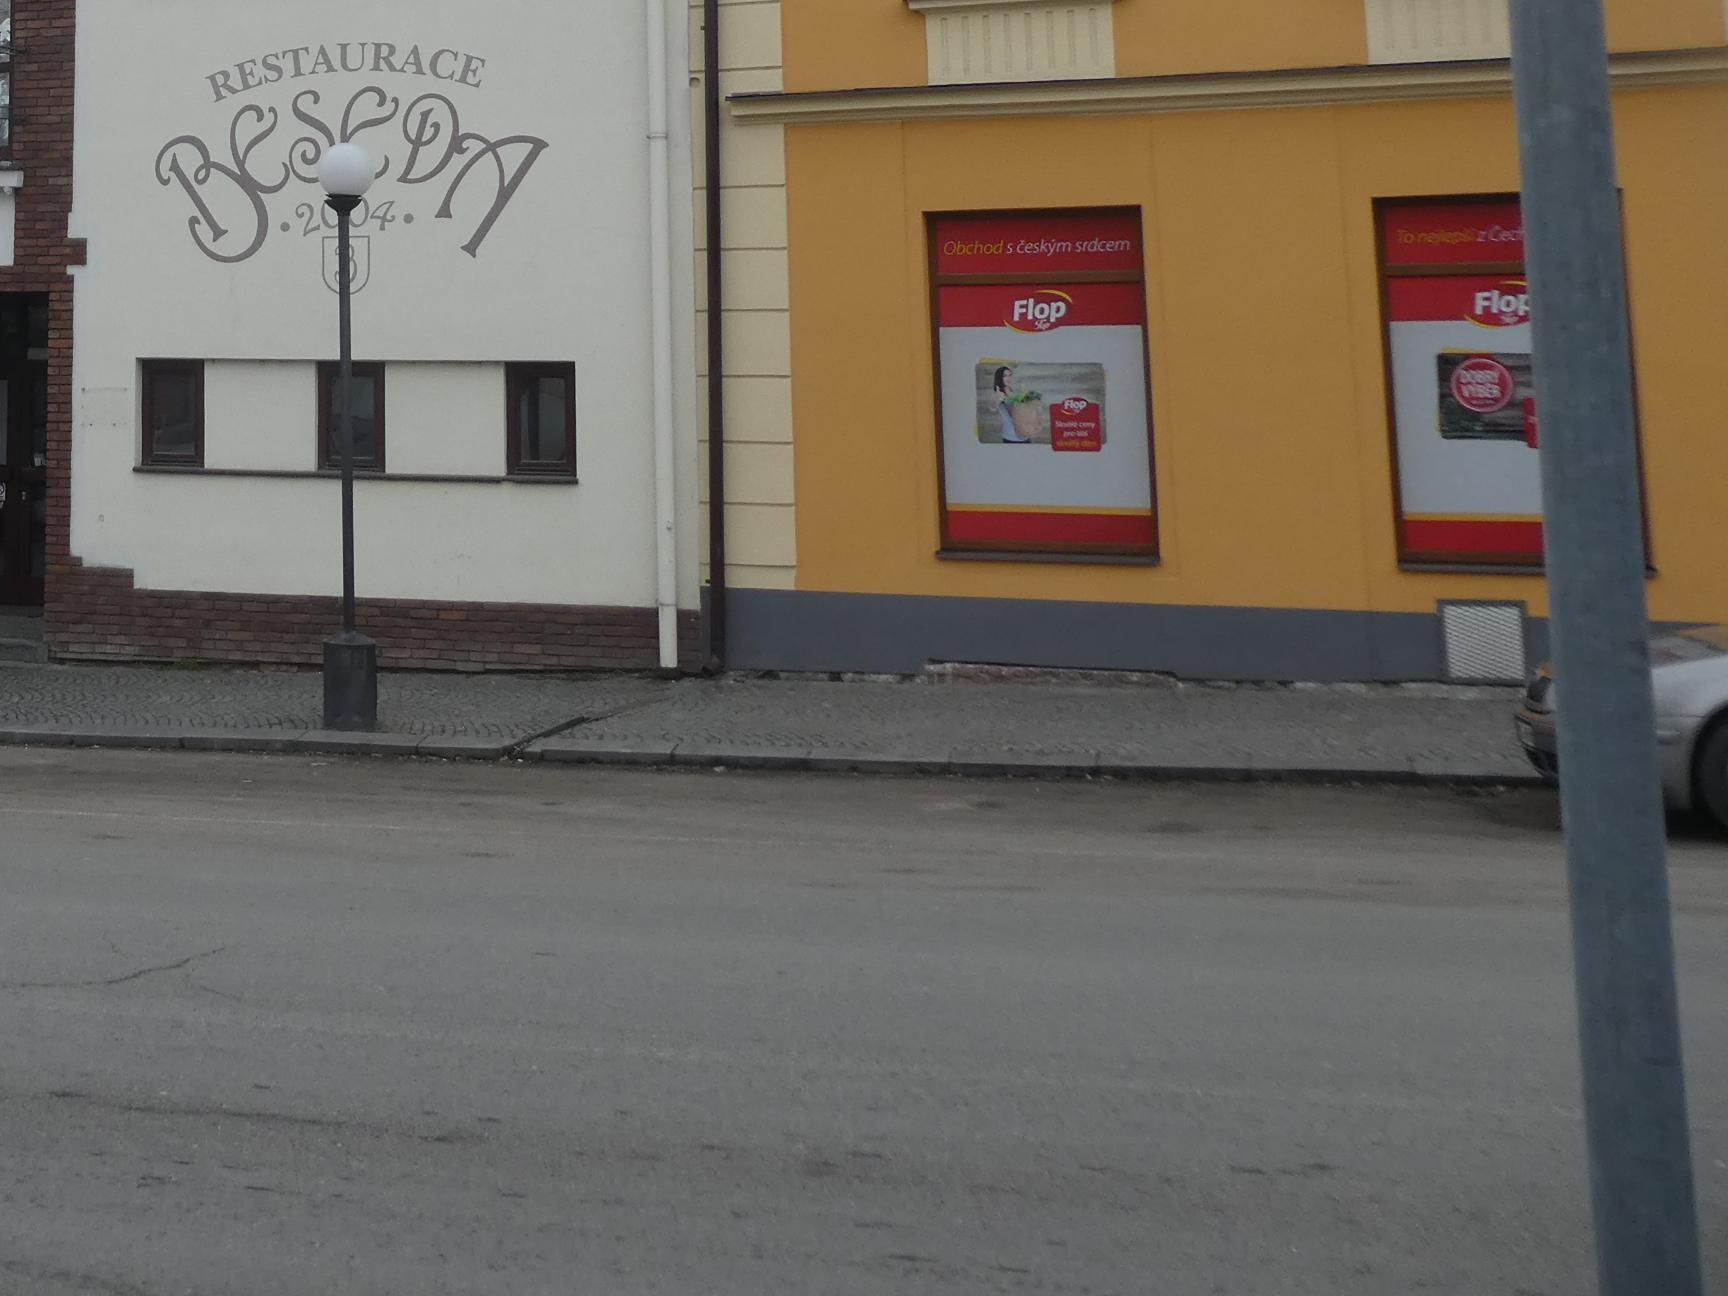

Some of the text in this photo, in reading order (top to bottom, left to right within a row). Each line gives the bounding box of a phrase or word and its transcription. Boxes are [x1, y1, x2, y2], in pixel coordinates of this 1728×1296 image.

[205, 42, 486, 102] RESTAURACE
[943, 238, 1131, 257] Obchod s českým srdcem
[1013, 298, 1066, 322] Flop
